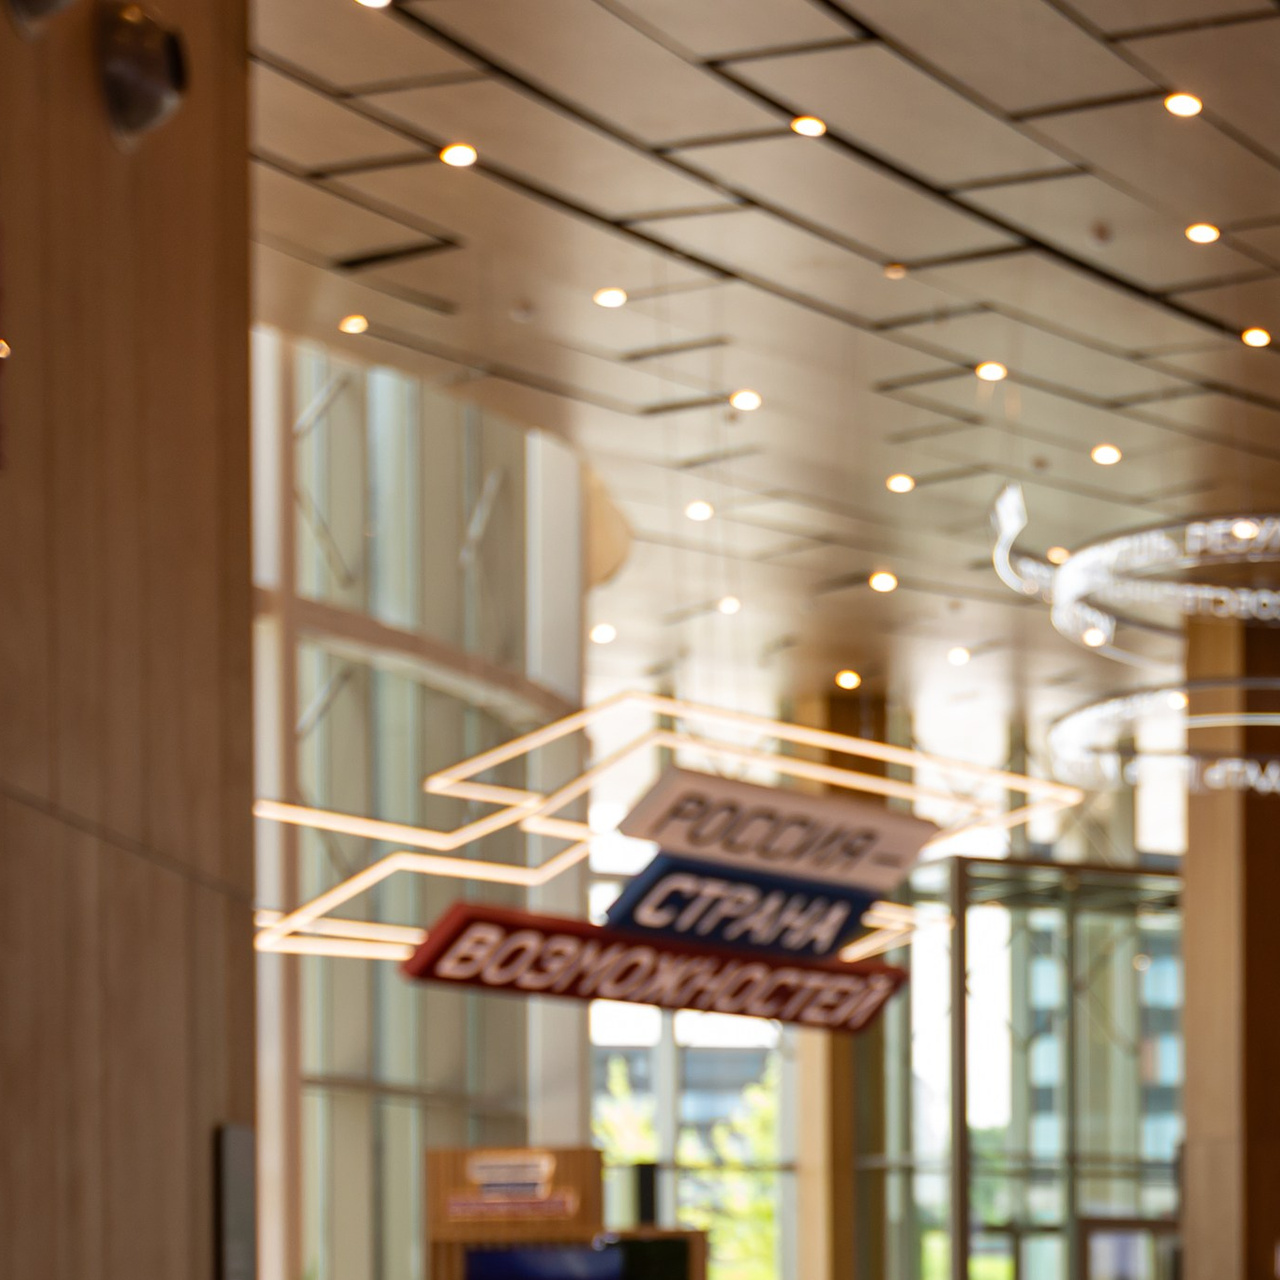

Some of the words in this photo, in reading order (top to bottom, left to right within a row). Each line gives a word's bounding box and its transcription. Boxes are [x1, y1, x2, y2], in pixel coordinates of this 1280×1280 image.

[650, 789, 880, 877] РОССИЯ
[633, 872, 851, 955] СТРАНА
[435, 921, 892, 1030] ВОЗМОЖНОСТЕЙ
